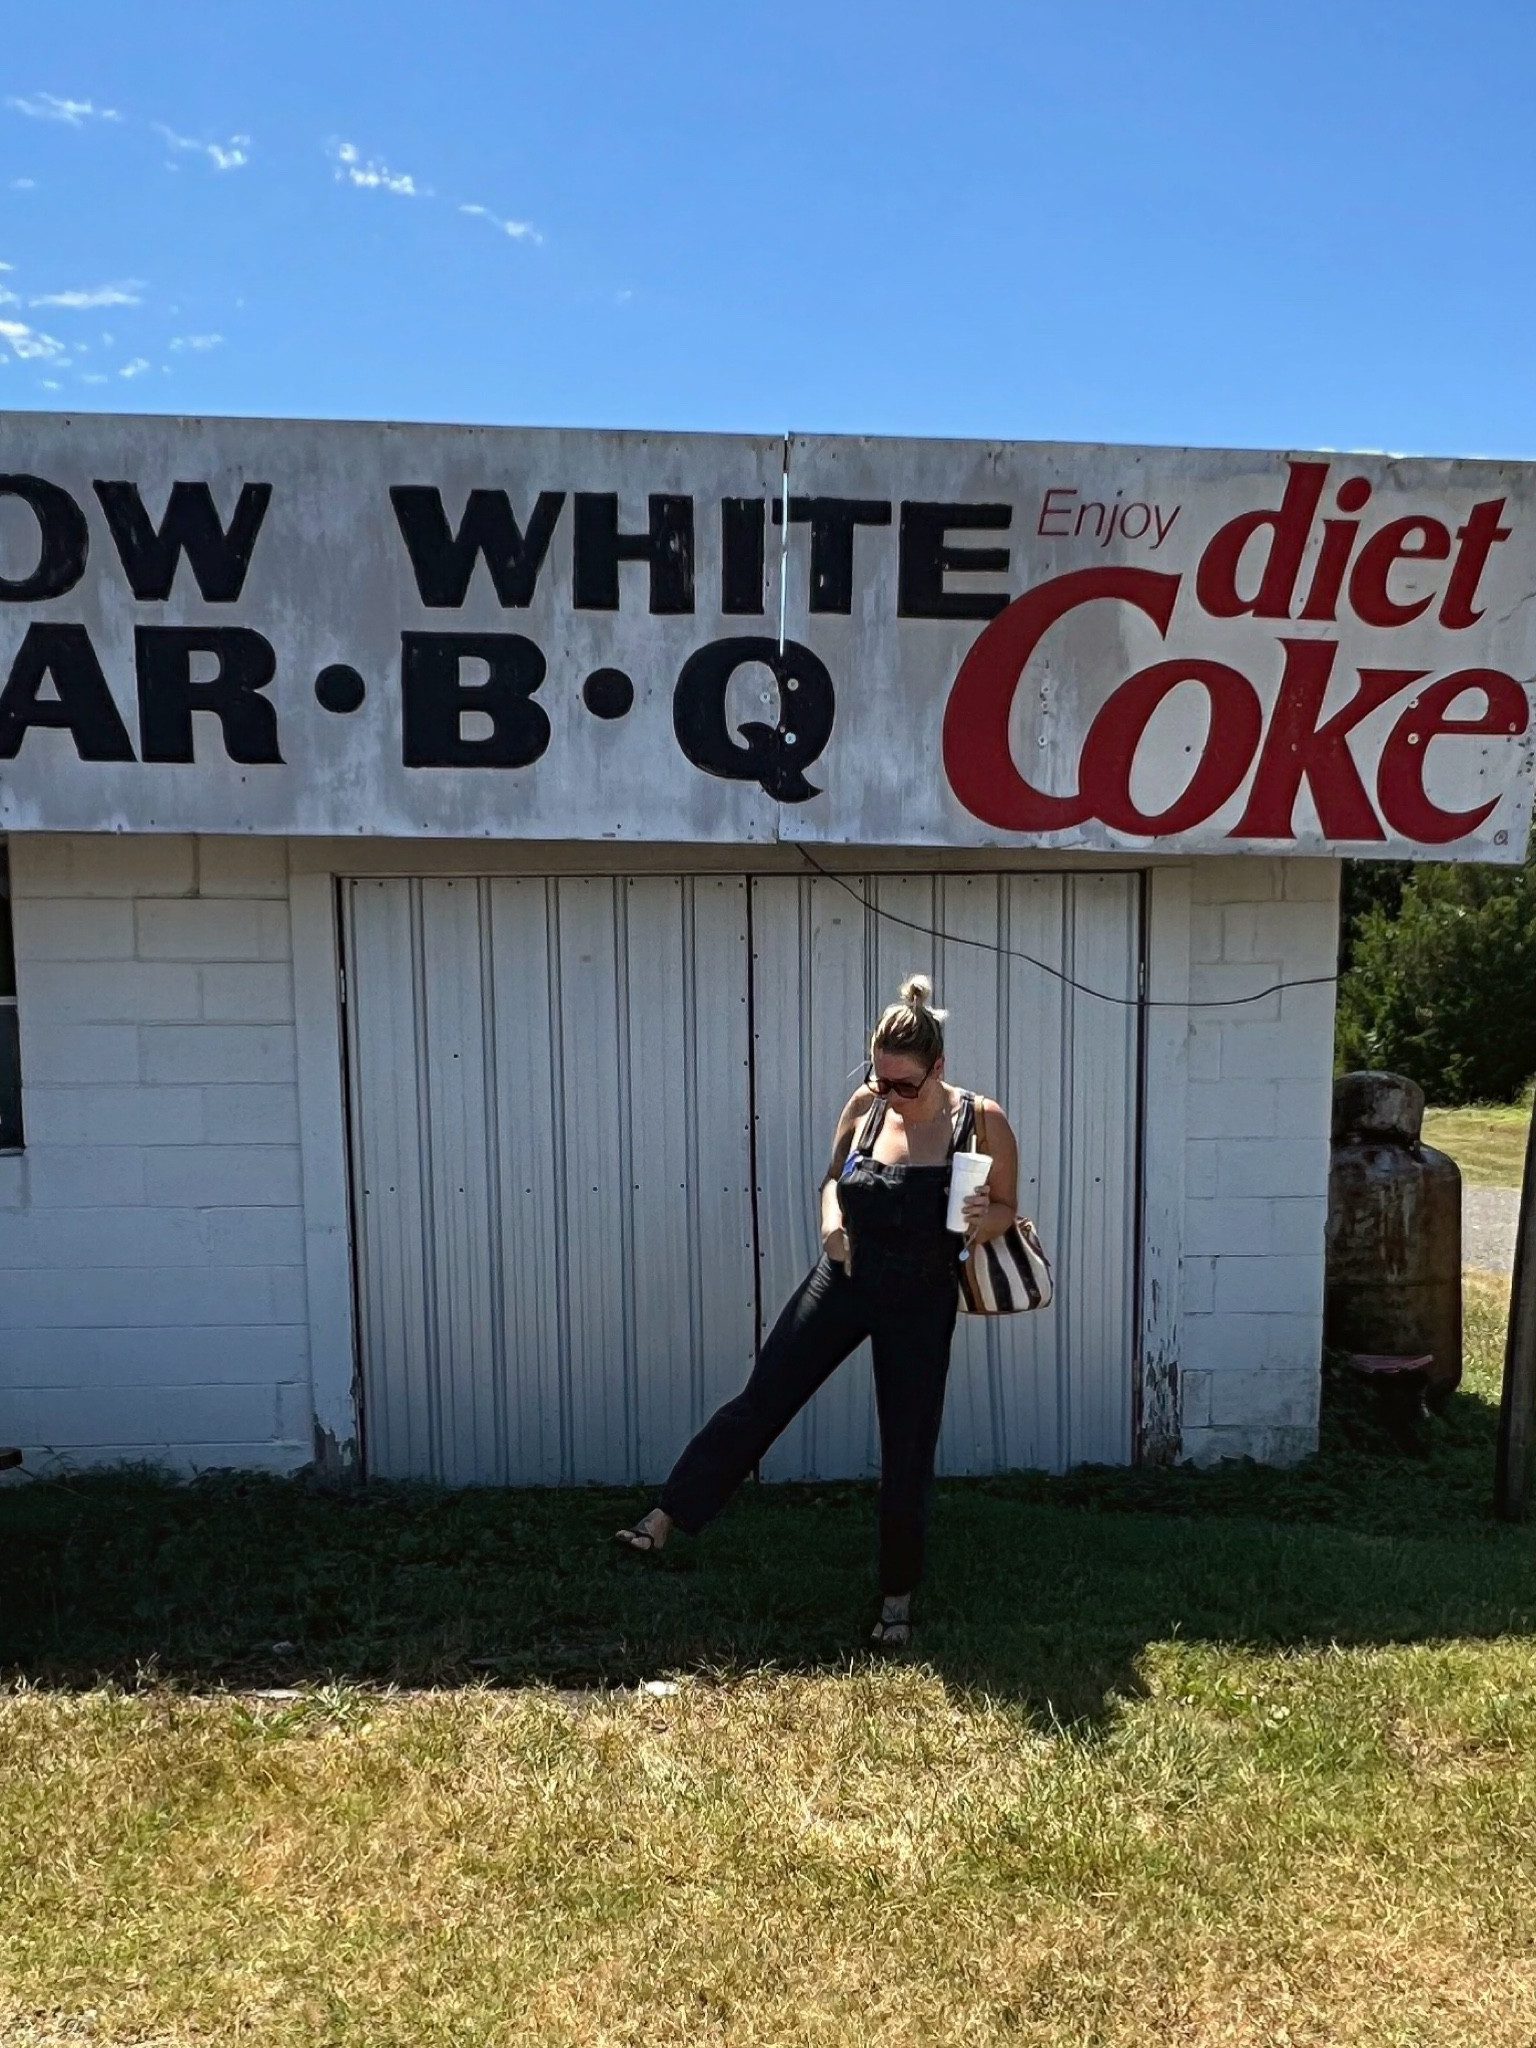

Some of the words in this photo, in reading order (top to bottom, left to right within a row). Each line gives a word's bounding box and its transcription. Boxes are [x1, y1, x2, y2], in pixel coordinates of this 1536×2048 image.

[389, 485, 1013, 620] WHITE
[1037, 489, 1182, 550] Enjoy
[1196, 461, 1512, 630] diet
[942, 565, 1530, 845] Coke
